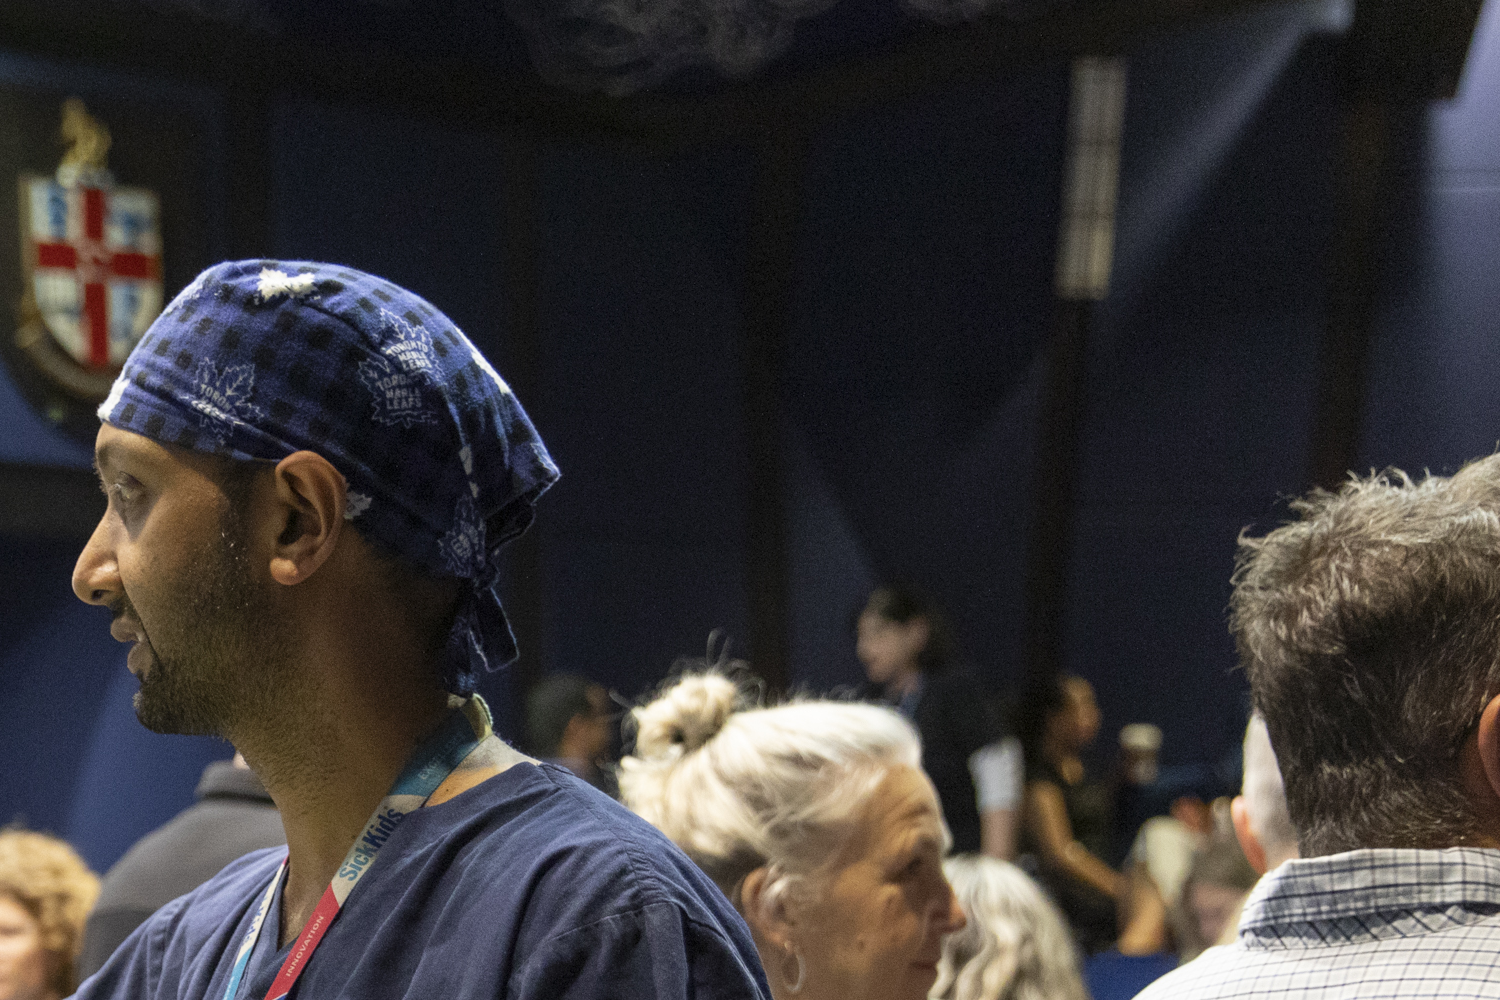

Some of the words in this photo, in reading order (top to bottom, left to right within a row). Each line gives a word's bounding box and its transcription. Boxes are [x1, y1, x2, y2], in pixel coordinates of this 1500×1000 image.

[375, 373, 408, 392] TORO
[386, 396, 422, 410] LEAFS
[338, 807, 405, 882] SickKids
[285, 914, 324, 978] INNOVATION
